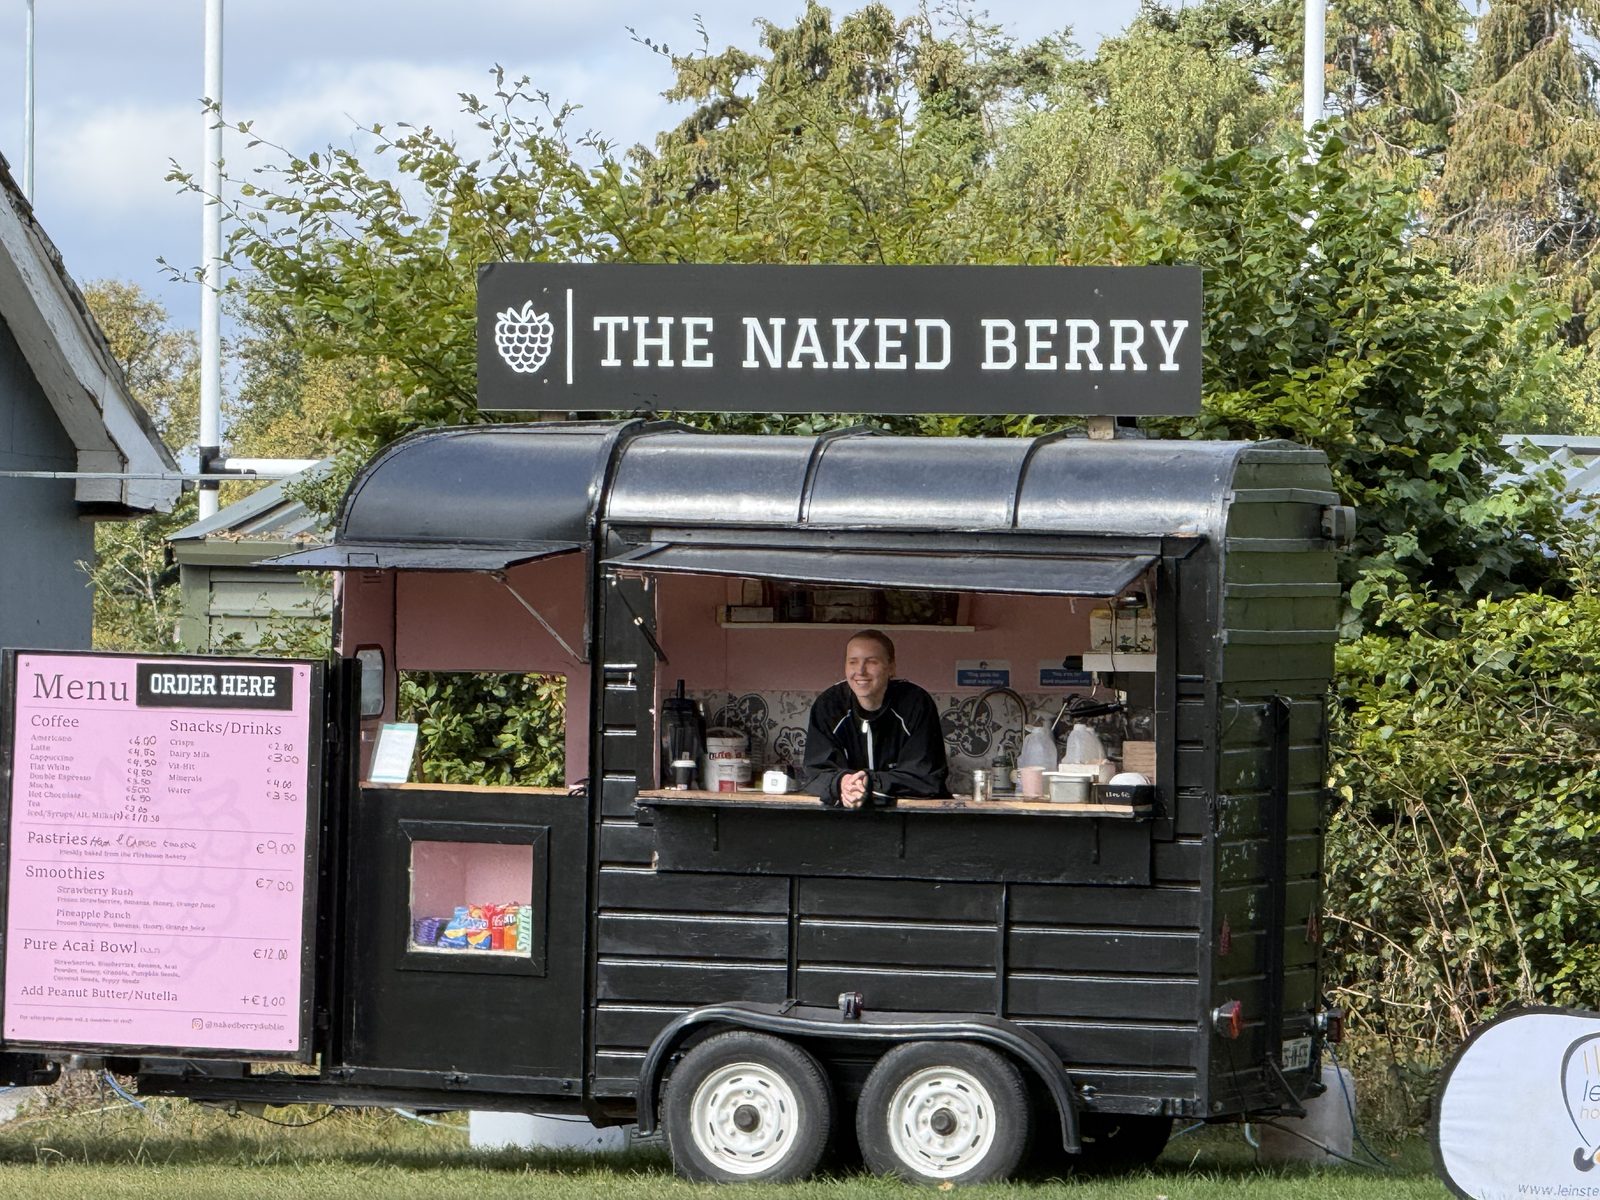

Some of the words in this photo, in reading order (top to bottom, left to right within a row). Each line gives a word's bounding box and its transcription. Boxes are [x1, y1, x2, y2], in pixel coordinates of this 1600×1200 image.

[593, 316, 714, 368] THE
[742, 317, 951, 371] NAKED
[981, 319, 1189, 372] BERRY
[33, 673, 129, 702] Menu
[150, 673, 217, 695] ORDER
[221, 675, 276, 697] HERE
[31, 714, 79, 729] Coffee
[169, 719, 282, 736] Snacks/Drinks
[30, 734, 72, 742] Americano
[30, 743, 51, 751] Latte
[27, 831, 88, 846] Pastries
[25, 866, 105, 880] Smoothies
[56, 886, 109, 897] Strawberry
[111, 887, 134, 896] Rush
[56, 909, 101, 920] Pineapple
[103, 910, 131, 920] Punch
[24, 937, 57, 951] Pure
[62, 939, 95, 953] Acai
[100, 940, 137, 954] Bowl
[21, 986, 44, 996] Add
[48, 987, 88, 998] Peanut
[92, 988, 178, 1002] Butter/Nutella
